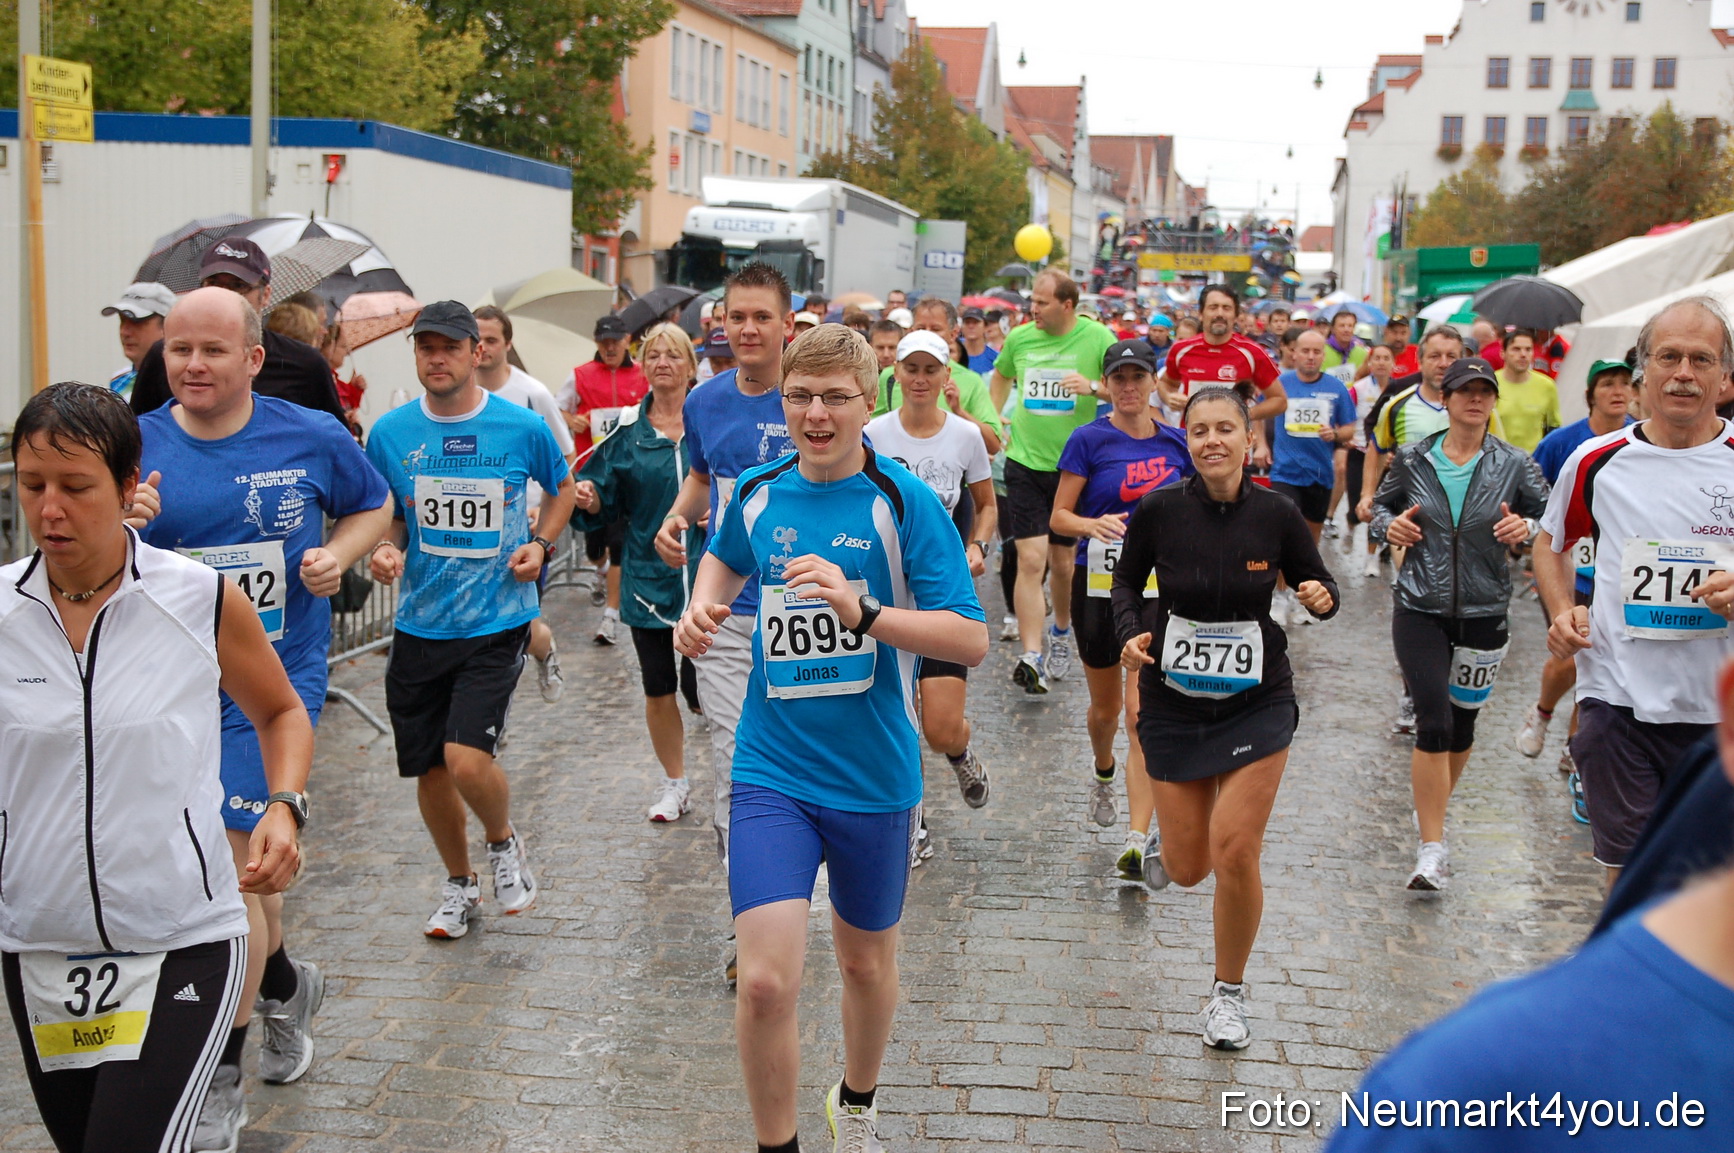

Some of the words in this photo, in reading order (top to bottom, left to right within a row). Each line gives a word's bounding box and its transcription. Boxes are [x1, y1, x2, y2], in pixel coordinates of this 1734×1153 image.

[714, 217, 775, 233] BOCK
[1174, 257, 1214, 267] START
[1294, 409, 1320, 423] 352
[424, 452, 510, 470] firmenlauf
[234, 475, 250, 485] 12.
[250, 468, 307, 481] NEUMARKTER
[1126, 456, 1167, 486] FAST
[249, 477, 299, 490] STADTLAUF
[424, 498, 492, 528] 3191
[444, 534, 473, 546] Rene
[844, 535, 872, 550] asics
[203, 551, 250, 565] BOCK
[1658, 546, 1705, 557] BOCK
[1650, 610, 1704, 626] Werner
[1172, 639, 1253, 675] 2579
[793, 665, 840, 682] Jonas
[1188, 677, 1233, 692] Renate
[64, 961, 121, 1018] 32
[173, 993, 201, 1002] adidas
